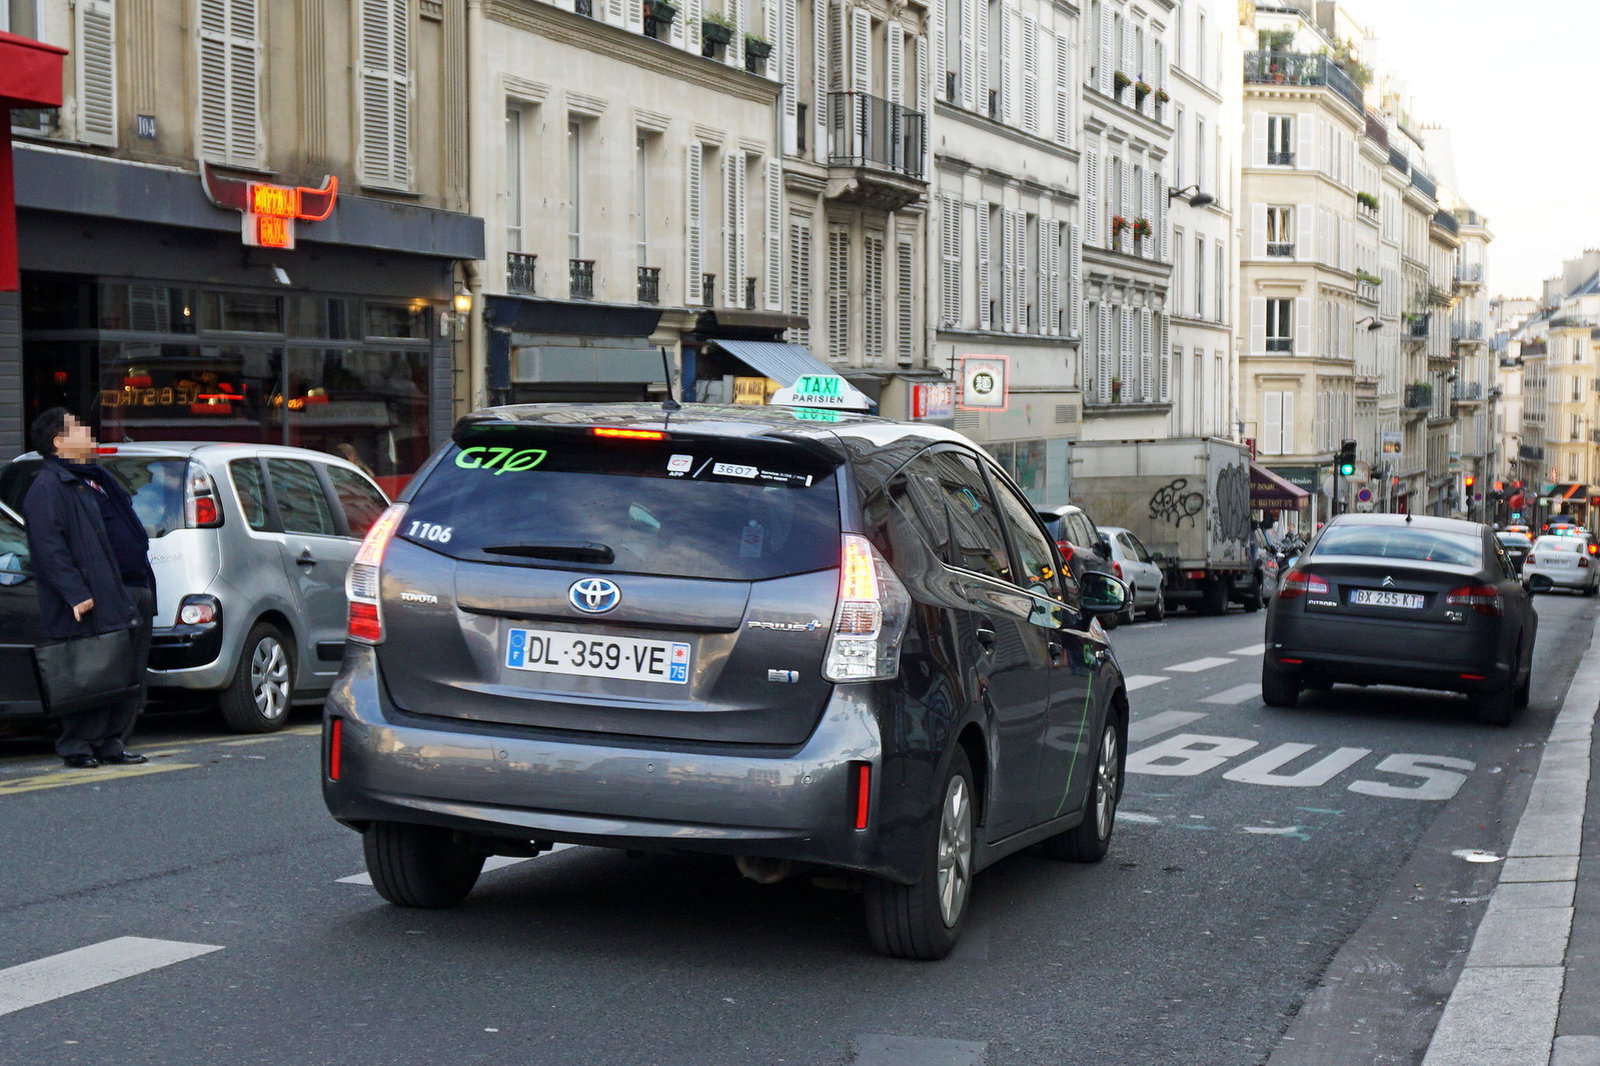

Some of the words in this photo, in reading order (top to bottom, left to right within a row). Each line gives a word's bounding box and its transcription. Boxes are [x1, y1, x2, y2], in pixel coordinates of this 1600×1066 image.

[138, 116, 156, 136] 104
[801, 376, 839, 394] TAXI
[792, 394, 844, 404] PARISIEN
[455, 446, 514, 469] G7
[717, 465, 752, 476] 3607
[409, 521, 452, 543] 1106
[401, 592, 438, 604] TOYOTA
[512, 651, 520, 660] F
[671, 665, 686, 679] 75
[1126, 733, 1477, 801] BUS
